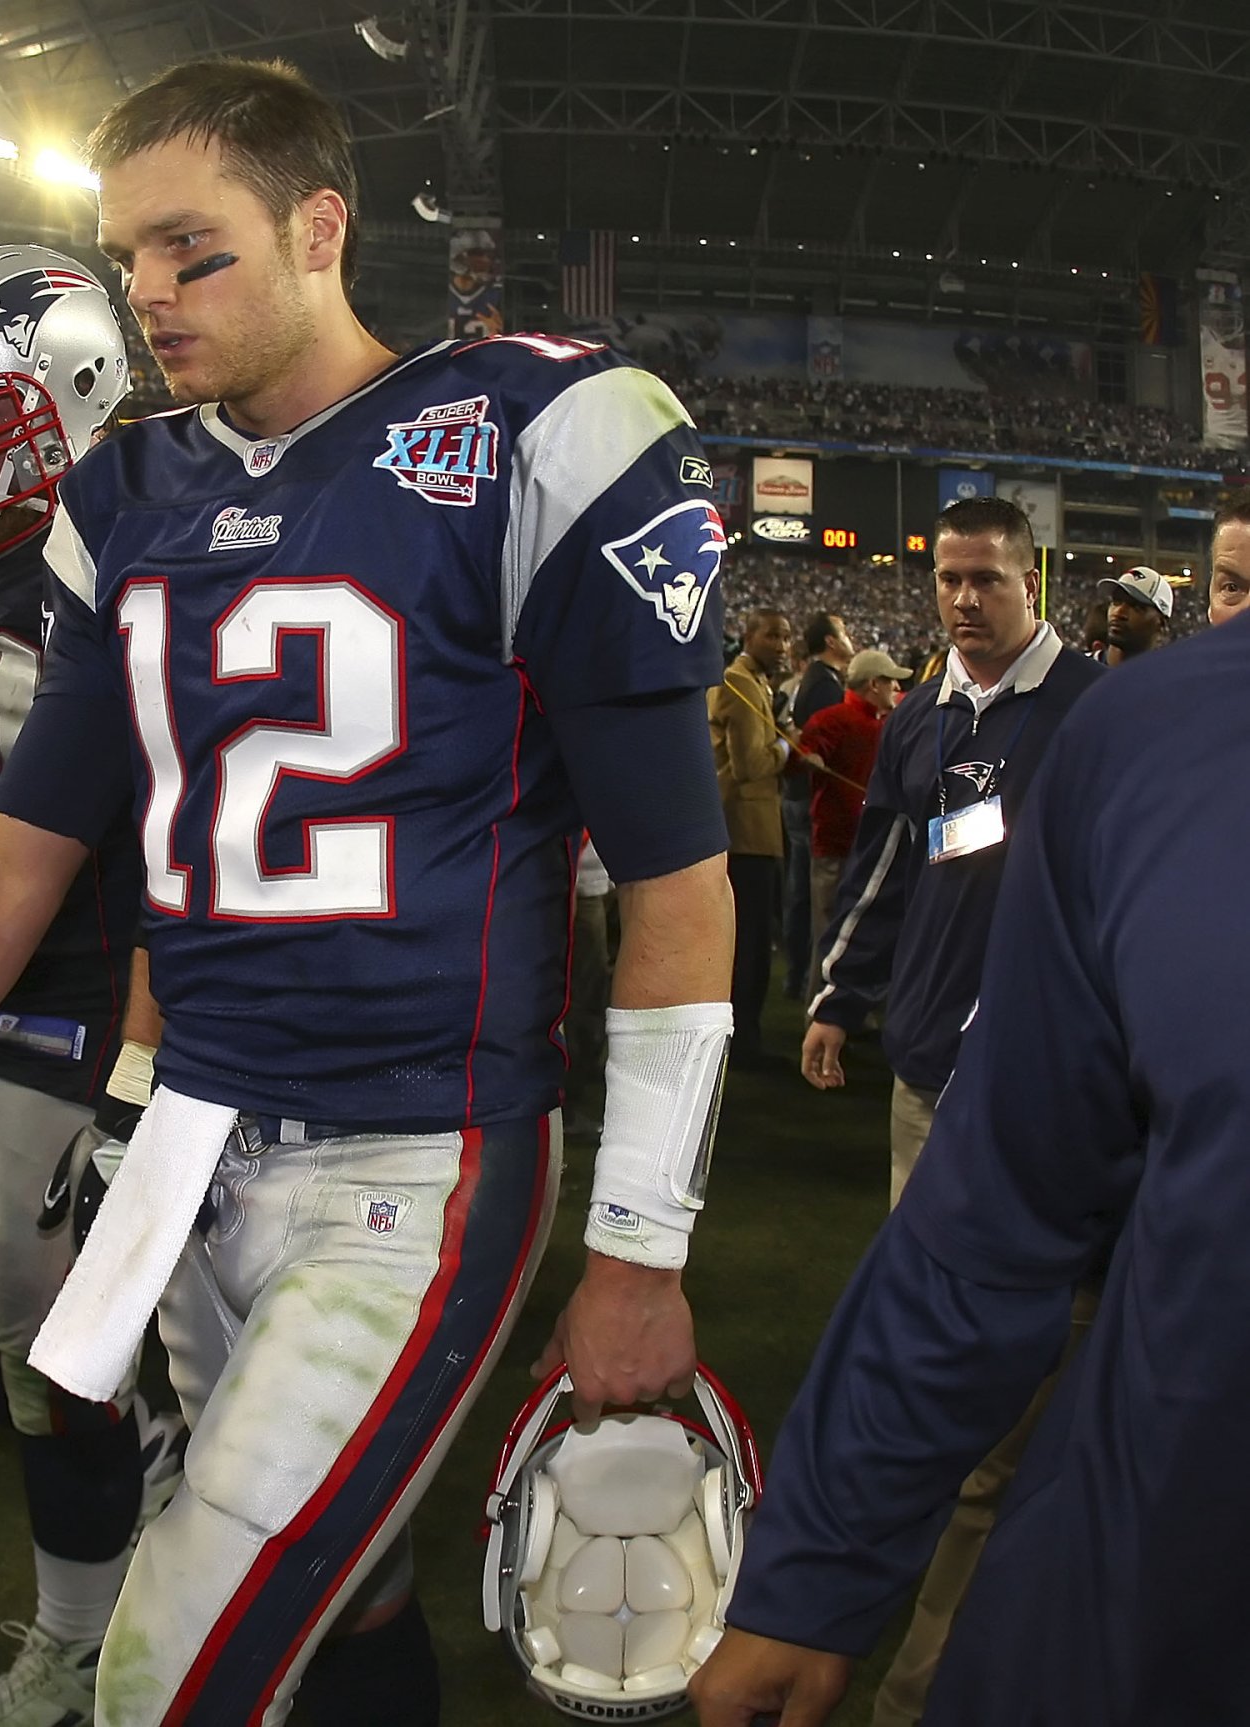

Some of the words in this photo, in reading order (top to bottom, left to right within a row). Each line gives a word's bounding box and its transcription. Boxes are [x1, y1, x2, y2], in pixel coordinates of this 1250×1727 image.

[426, 403, 476, 420] SUPER
[380, 426, 491, 475] XLII
[253, 454, 272, 468] NFL
[416, 472, 460, 487] BOWL
[211, 514, 282, 550] Patriots
[114, 574, 407, 923] 12
[361, 1191, 409, 1206] EQUIPMENT
[369, 1214, 393, 1230] NFL
[554, 1694, 688, 1718] PATRIOTS
